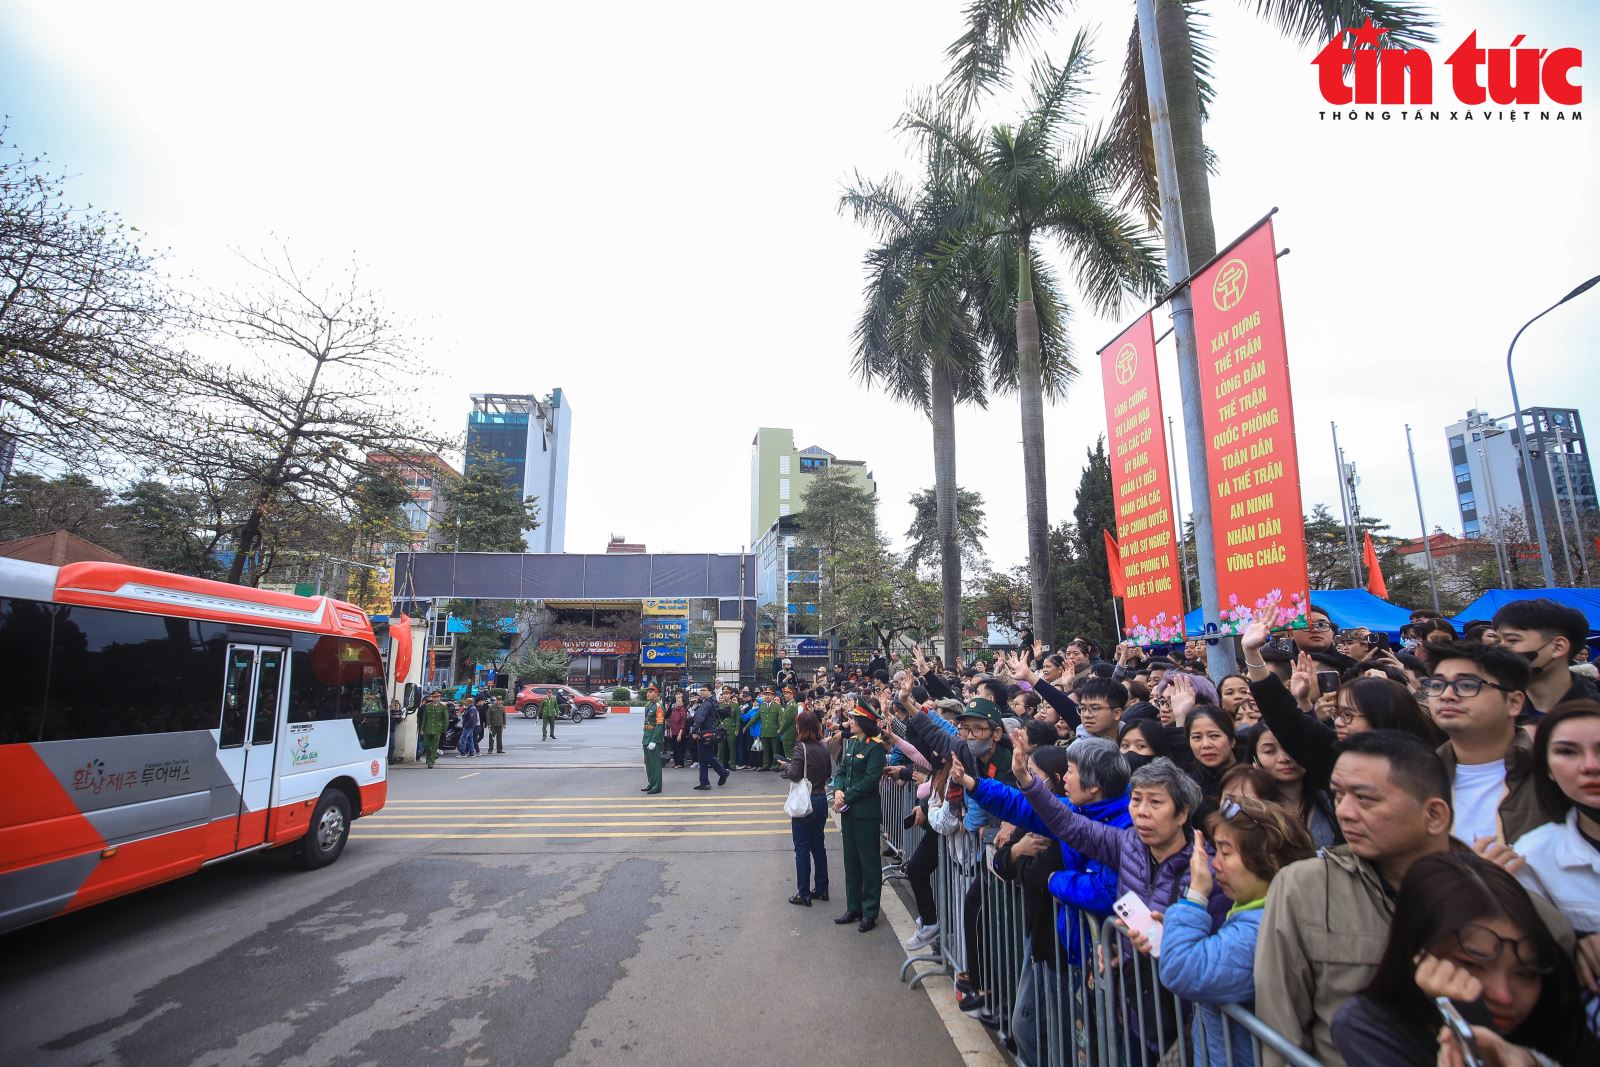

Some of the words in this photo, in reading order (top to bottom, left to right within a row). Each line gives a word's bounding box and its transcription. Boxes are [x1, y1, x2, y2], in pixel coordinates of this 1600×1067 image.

[1211, 330, 1229, 353] XÂY
[1232, 310, 1261, 339] DỰNG
[1213, 348, 1232, 375] THẾ
[1234, 335, 1262, 363] TRẬN
[1215, 373, 1242, 400] LÒNG
[1243, 360, 1266, 386] DÂN
[1218, 395, 1237, 423] THẾ
[1238, 385, 1267, 414] TRẬN
[1213, 422, 1240, 450] QUỐC
[1241, 407, 1279, 438] PHÒNG
[1222, 446, 1248, 472] TOÀN
[1250, 437, 1274, 461] DÂN
[1217, 480, 1231, 498] VÀ
[1232, 466, 1252, 494] THẾ
[1253, 461, 1283, 485] TRẬN
[1230, 502, 1244, 520] AN
[1246, 492, 1274, 515] NINH
[1227, 523, 1256, 547] NHÂN
[1258, 517, 1281, 539] DÂN
[1226, 551, 1254, 573] VỮNG
[1256, 540, 1286, 567] CHẮC
[73, 768, 139, 794] 환상제주
[141, 765, 191, 786] 투어버스
